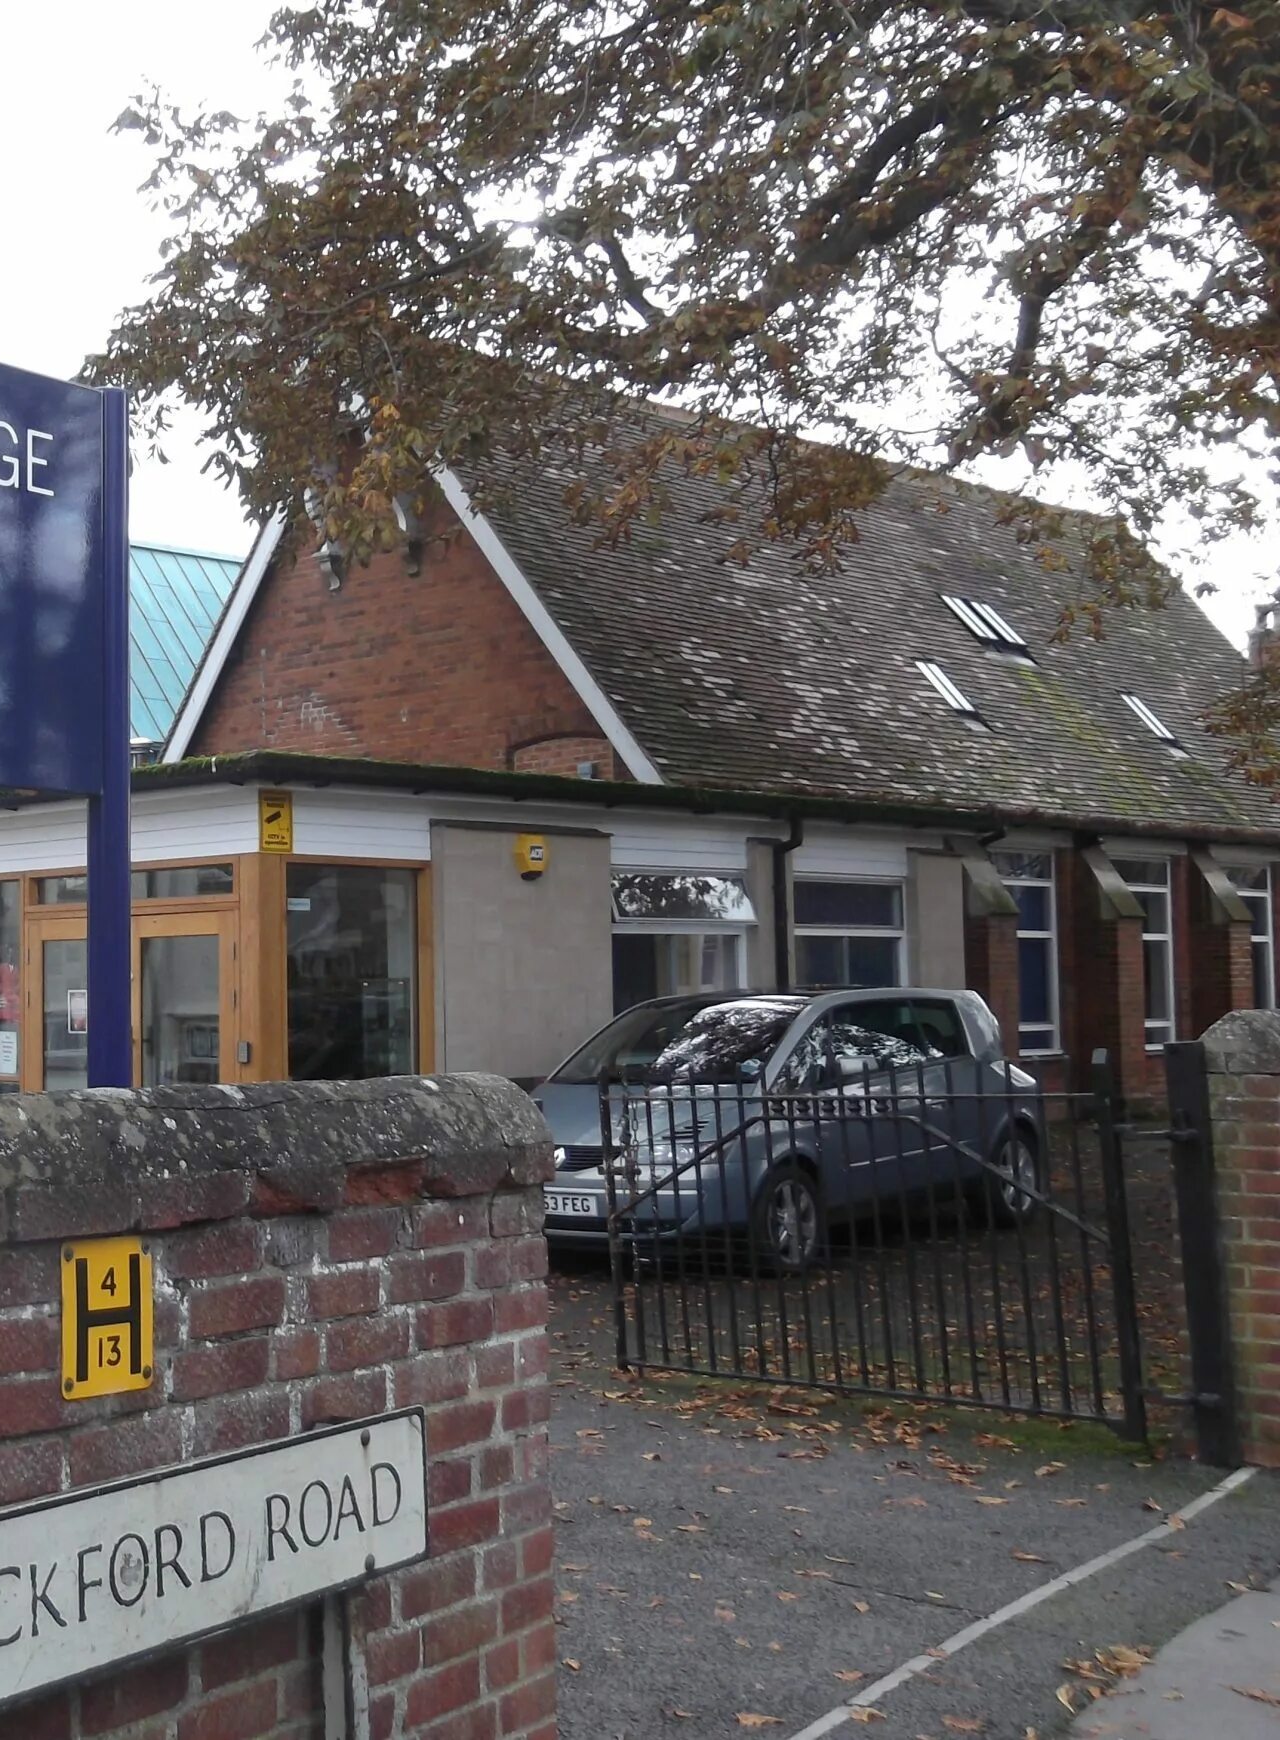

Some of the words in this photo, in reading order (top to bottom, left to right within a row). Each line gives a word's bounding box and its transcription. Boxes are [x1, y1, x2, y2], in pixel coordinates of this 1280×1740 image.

[561, 1196, 591, 1213] FEG
[100, 1266, 117, 1297] 4
[75, 1253, 142, 1383] H
[98, 1335, 121, 1368] 13
[265, 1462, 402, 1562] ROAD
